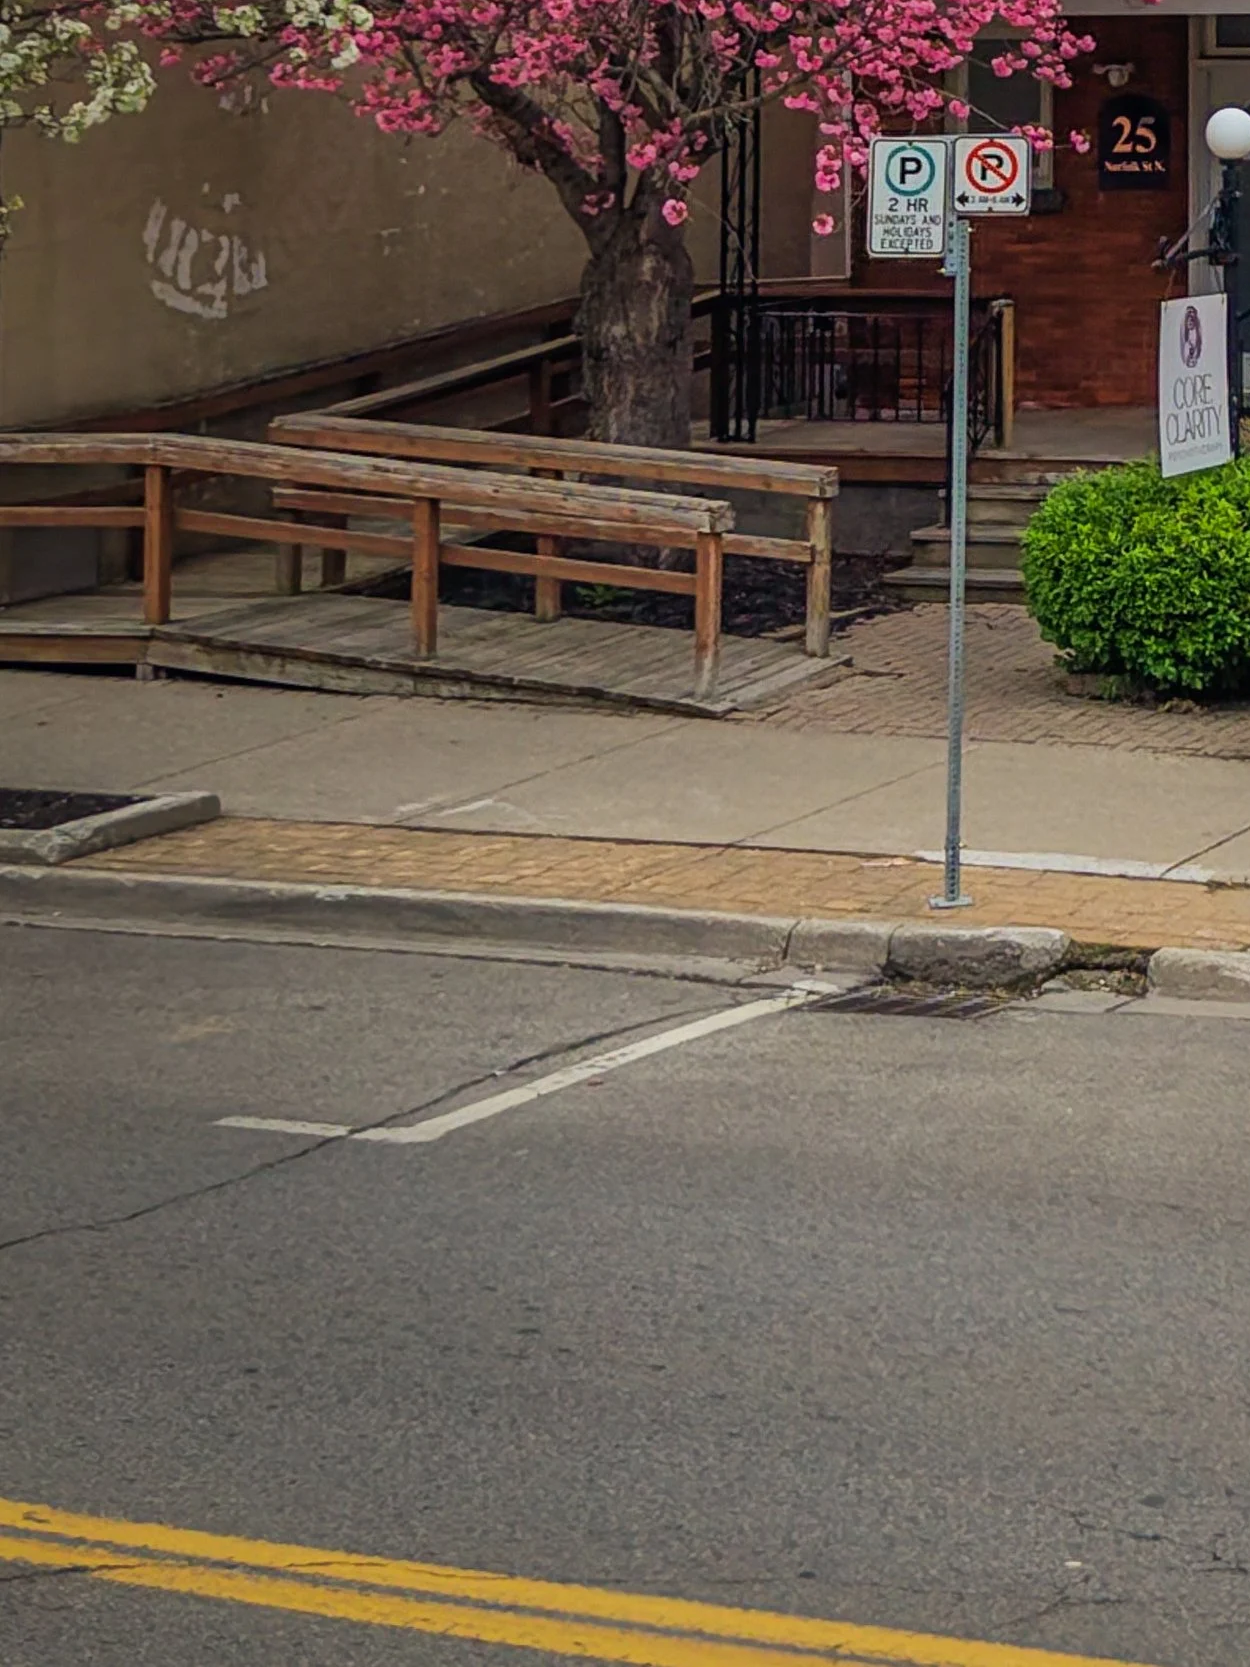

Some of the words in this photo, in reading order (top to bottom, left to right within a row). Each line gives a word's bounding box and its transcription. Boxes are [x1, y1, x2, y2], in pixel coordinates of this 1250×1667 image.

[1112, 116, 1157, 153] 25
[900, 157, 923, 184] P
[888, 198, 899, 212] 2
[907, 198, 929, 212] HR
[874, 214, 917, 226] SUNDAYS
[922, 216, 942, 226] AND
[883, 227, 932, 238] HOLIDAYS
[881, 238, 934, 250] EXCEPTED
[1173, 374, 1214, 410] CORE
[1166, 405, 1222, 446] CLARITY
